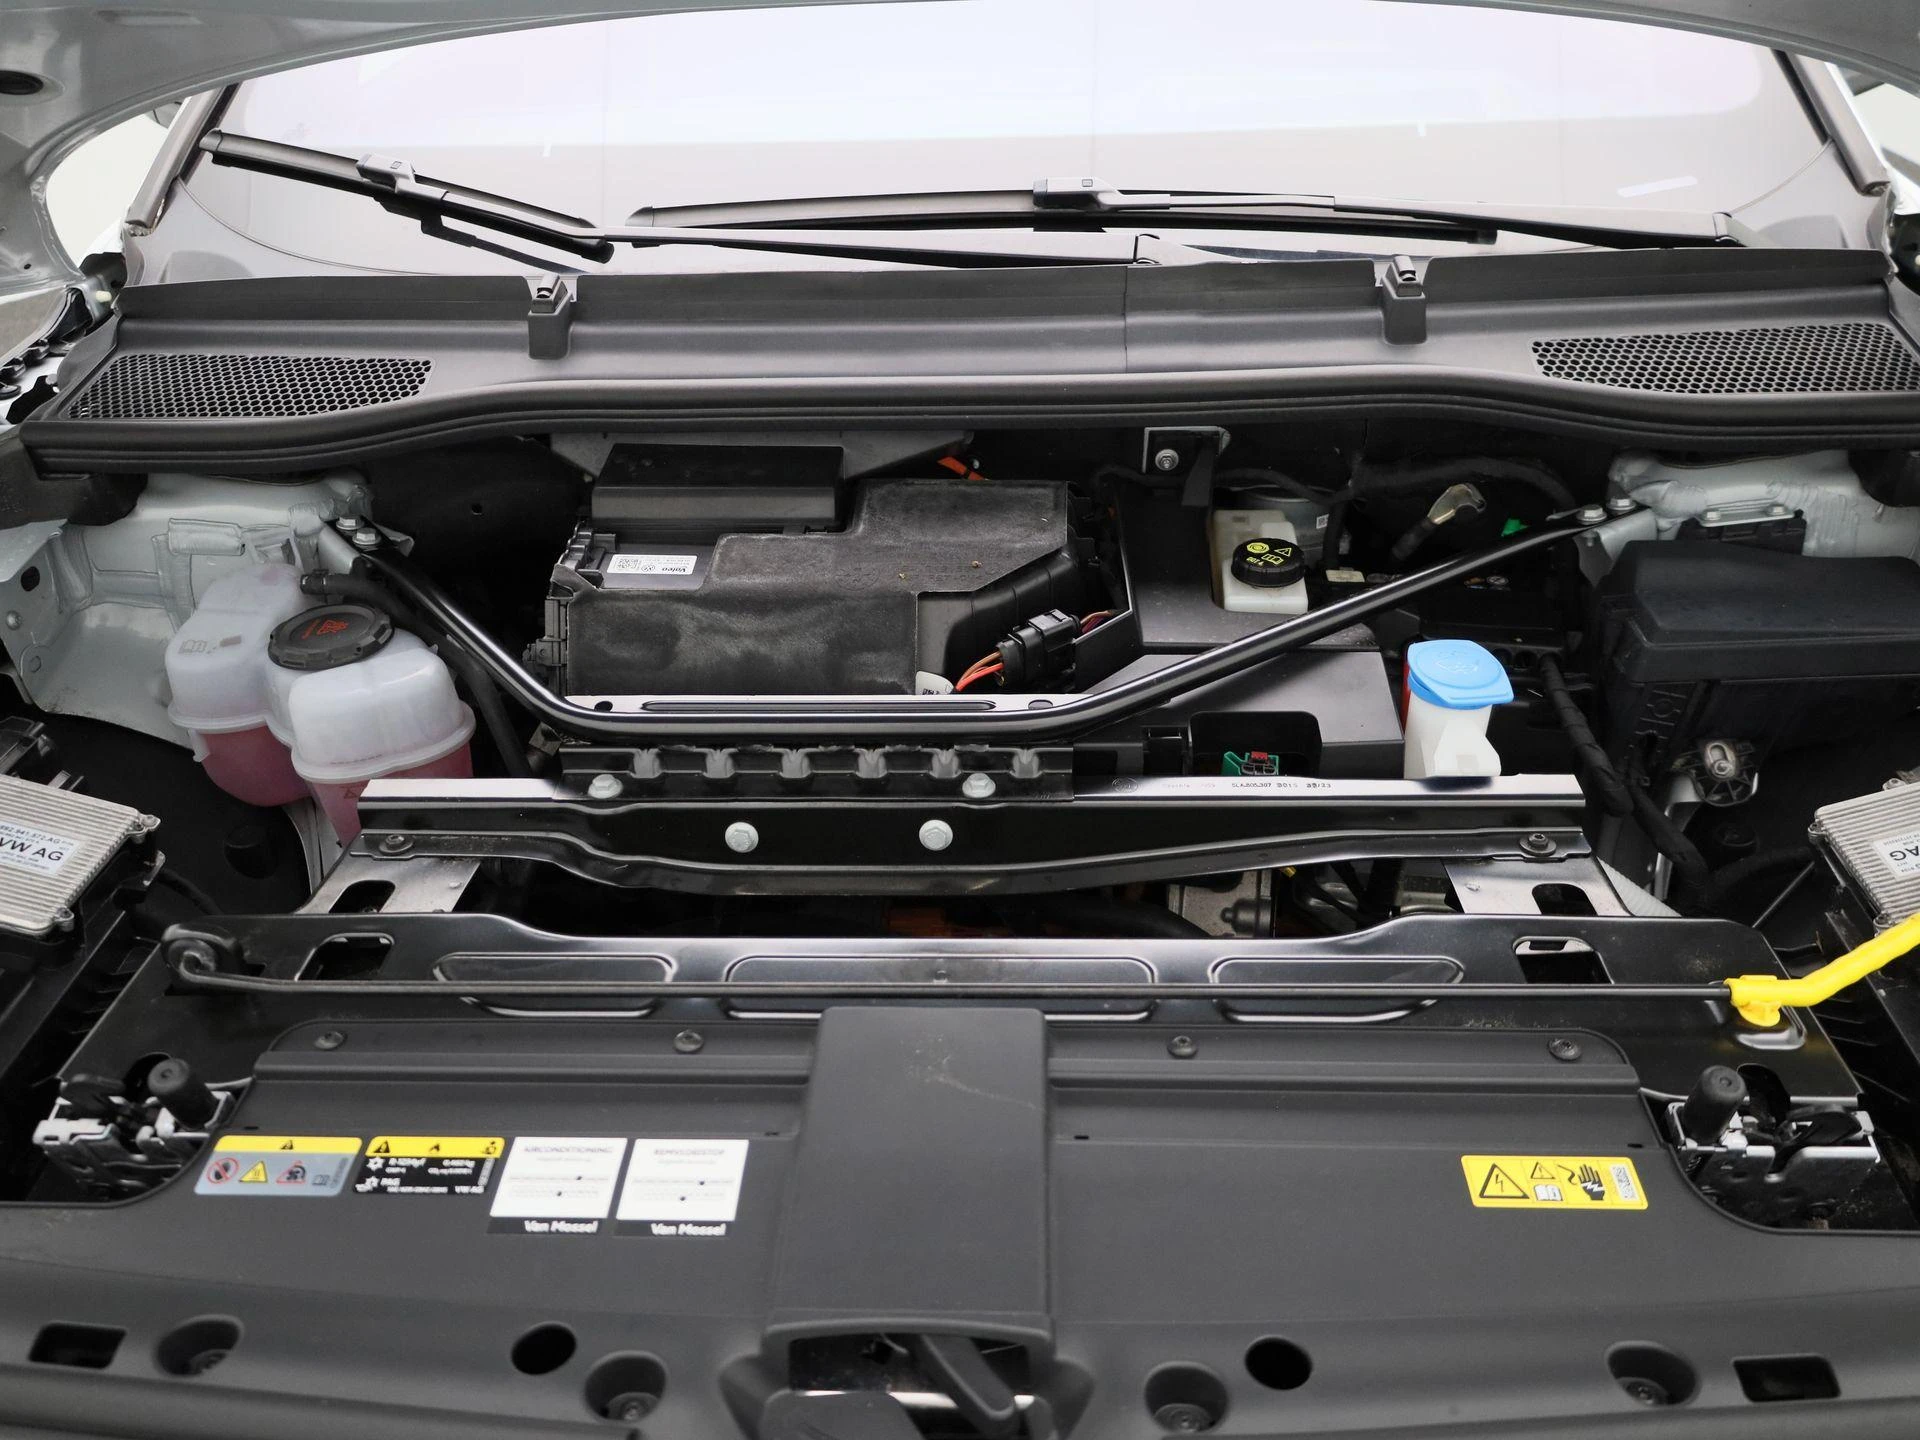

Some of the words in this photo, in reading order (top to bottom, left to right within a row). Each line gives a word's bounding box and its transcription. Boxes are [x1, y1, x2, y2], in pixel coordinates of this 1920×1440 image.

[0, 837, 32, 852] VW
[32, 847, 63, 861] AG
[1890, 845, 1919, 860] AG
[524, 1220, 549, 1232] Van
[651, 1223, 677, 1235] Van
